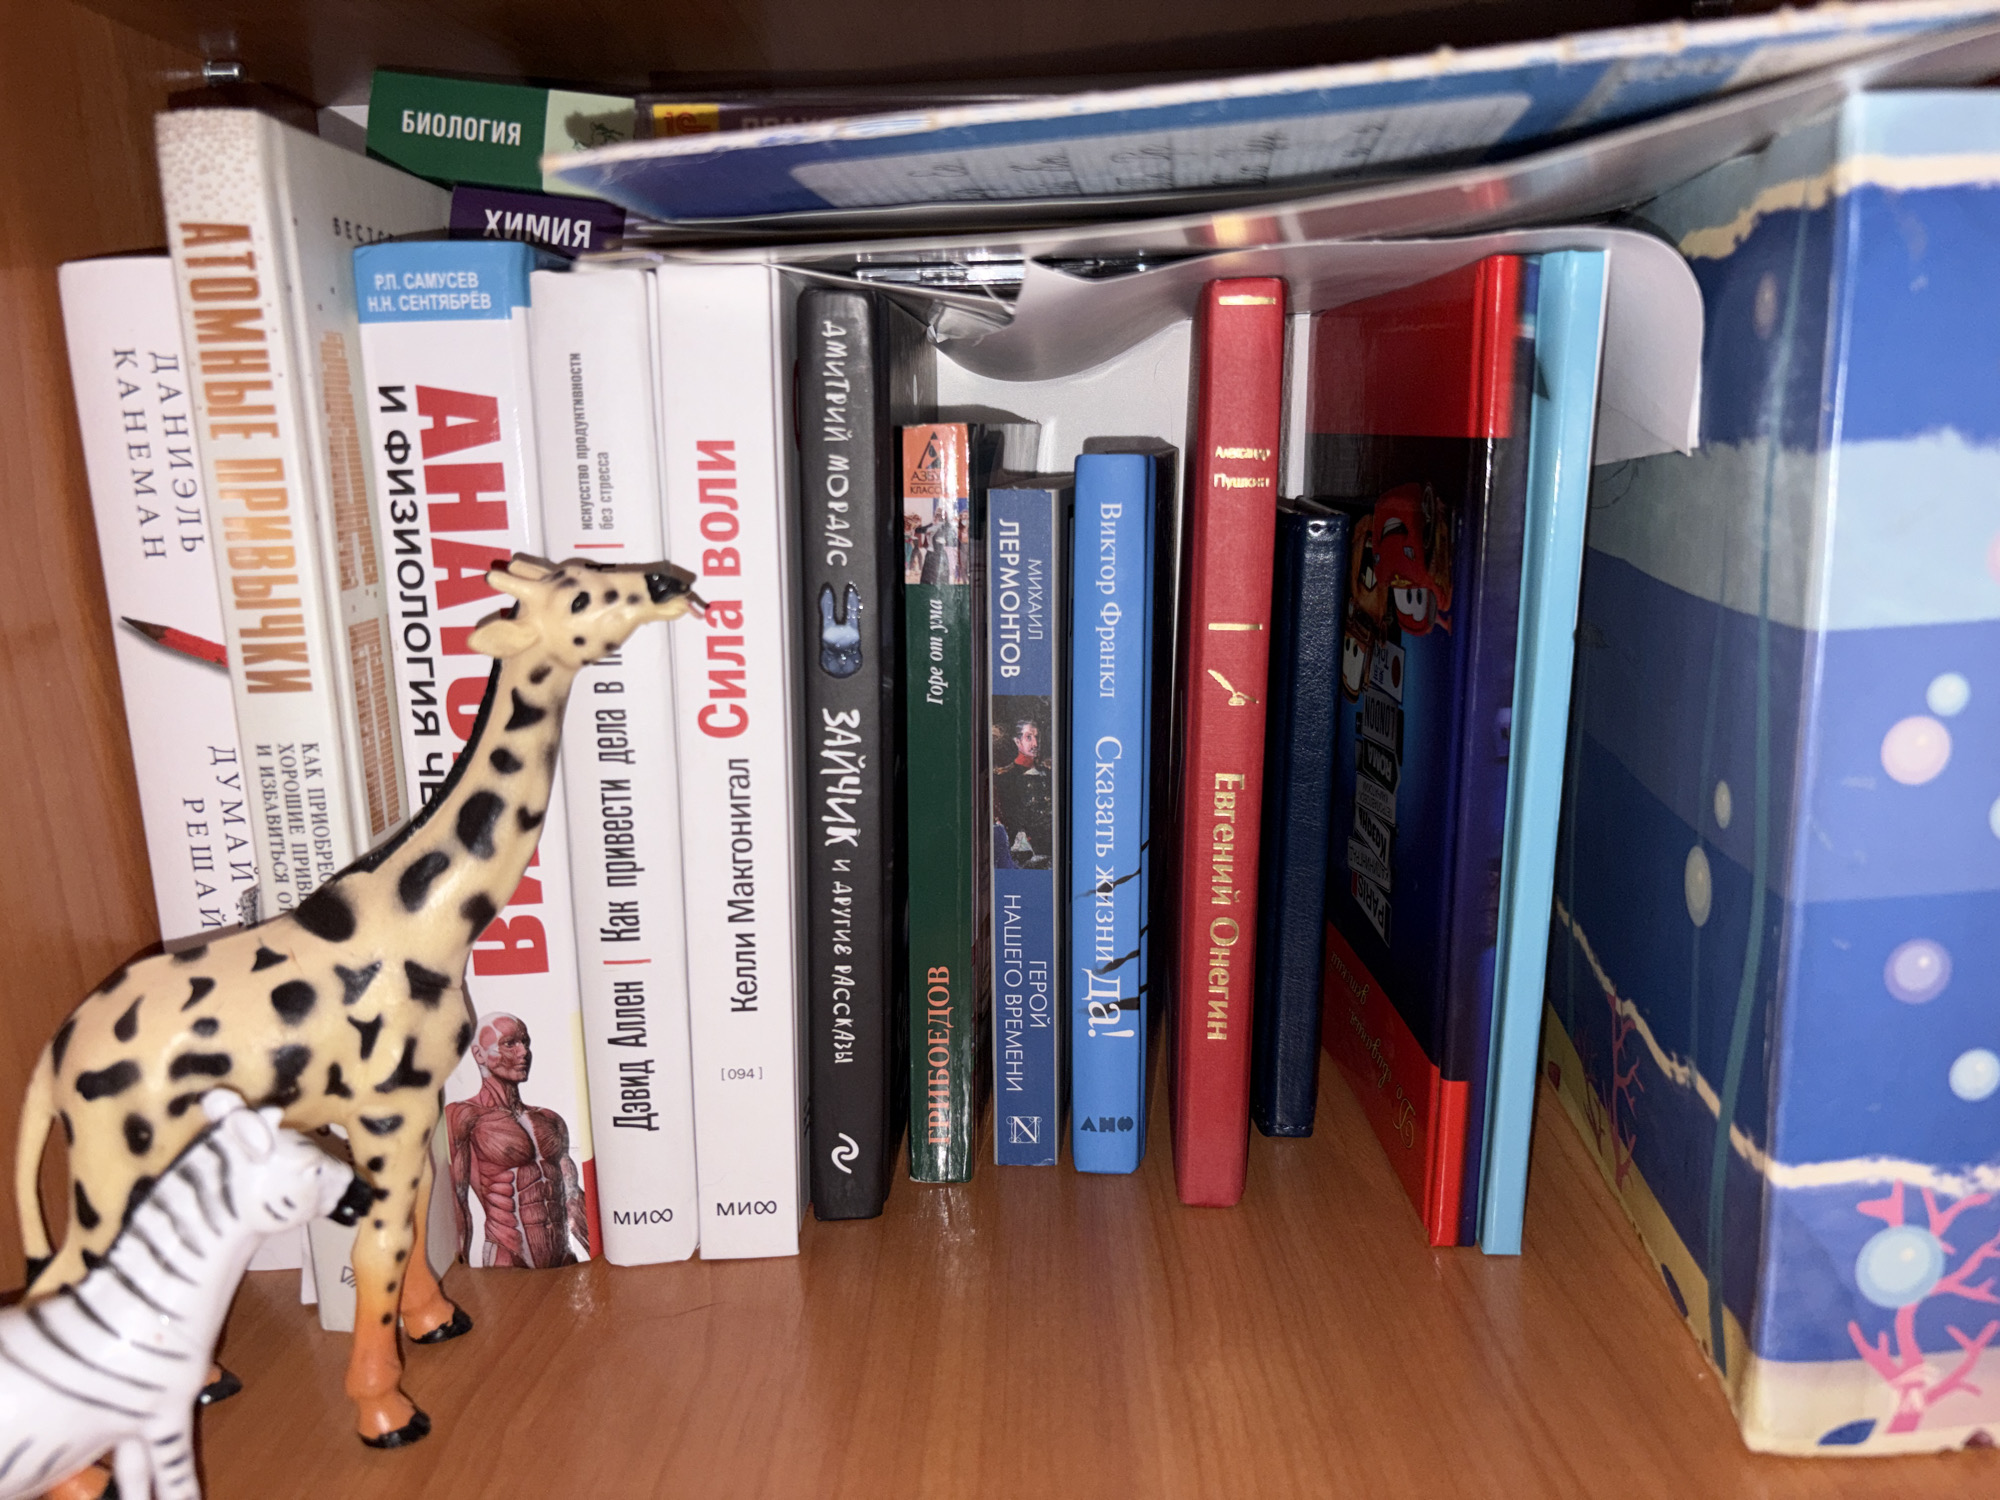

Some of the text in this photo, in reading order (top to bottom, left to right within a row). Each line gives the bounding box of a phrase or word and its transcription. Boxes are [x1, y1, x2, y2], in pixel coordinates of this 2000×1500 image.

[402, 110, 521, 146] БИОЛОГИЯ
[375, 272, 479, 291] Р.П. САМУСЕВ
[484, 209, 592, 248] ХИМИЯ
[367, 291, 491, 312] Н.Н. СЕНТЯБРЁВ
[112, 347, 167, 560] КАНЕМАН
[149, 351, 205, 554] ДАНИЭЛЬ
[378, 384, 406, 413] И
[569, 352, 593, 531] искусство продуктивности
[822, 321, 854, 567] ДМИТРИЙ МОРДАС
[178, 220, 312, 694] АТОМНЫЕ ПРИВЫЧКИ
[598, 451, 614, 531] без стресса
[383, 429, 441, 736] ФИЗИОЛОГИЯ
[696, 440, 750, 739] Сила воли
[999, 518, 1020, 678] ЛЕРМОНТОВ
[1027, 558, 1044, 641] МИХАИЛ
[1096, 502, 1122, 698] Виктор Франкл
[594, 681, 625, 694] в
[926, 599, 949, 706] Горе от ума
[256, 744, 272, 757] И
[598, 708, 636, 765] дела
[1364, 695, 1396, 740] LONDON
[1367, 742, 1393, 783] ROMA
[208, 745, 259, 883] ДУМАЙ
[259, 765, 290, 884] ИЗБАВИТЬСЯ
[277, 743, 305, 834] ХОРОШИЕ
[301, 742, 335, 884] КАК ПРИОБРЕС
[602, 778, 646, 887] привести
[820, 708, 864, 848] ЗАЙЧИК
[183, 797, 227, 928] РЕШАЙ
[726, 757, 759, 1013] Келли Макгонигал
[831, 880, 853, 956] ДРУГИЕ
[1081, 736, 1135, 1038] Сказать жизни Да!
[1206, 773, 1245, 1041] Евгений Онегин
[1358, 875, 1385, 926] PARIS
[600, 900, 641, 943] Как
[831, 964, 853, 1065] РАССКАЗЫ
[1003, 894, 1023, 1091] НАШЕГО ВРЕМЕНИ
[1028, 960, 1051, 1029] ГЕРОЙ
[606, 980, 660, 1132] Дэвид Аллен
[926, 965, 953, 1146] ГРИБОЕДОВ
